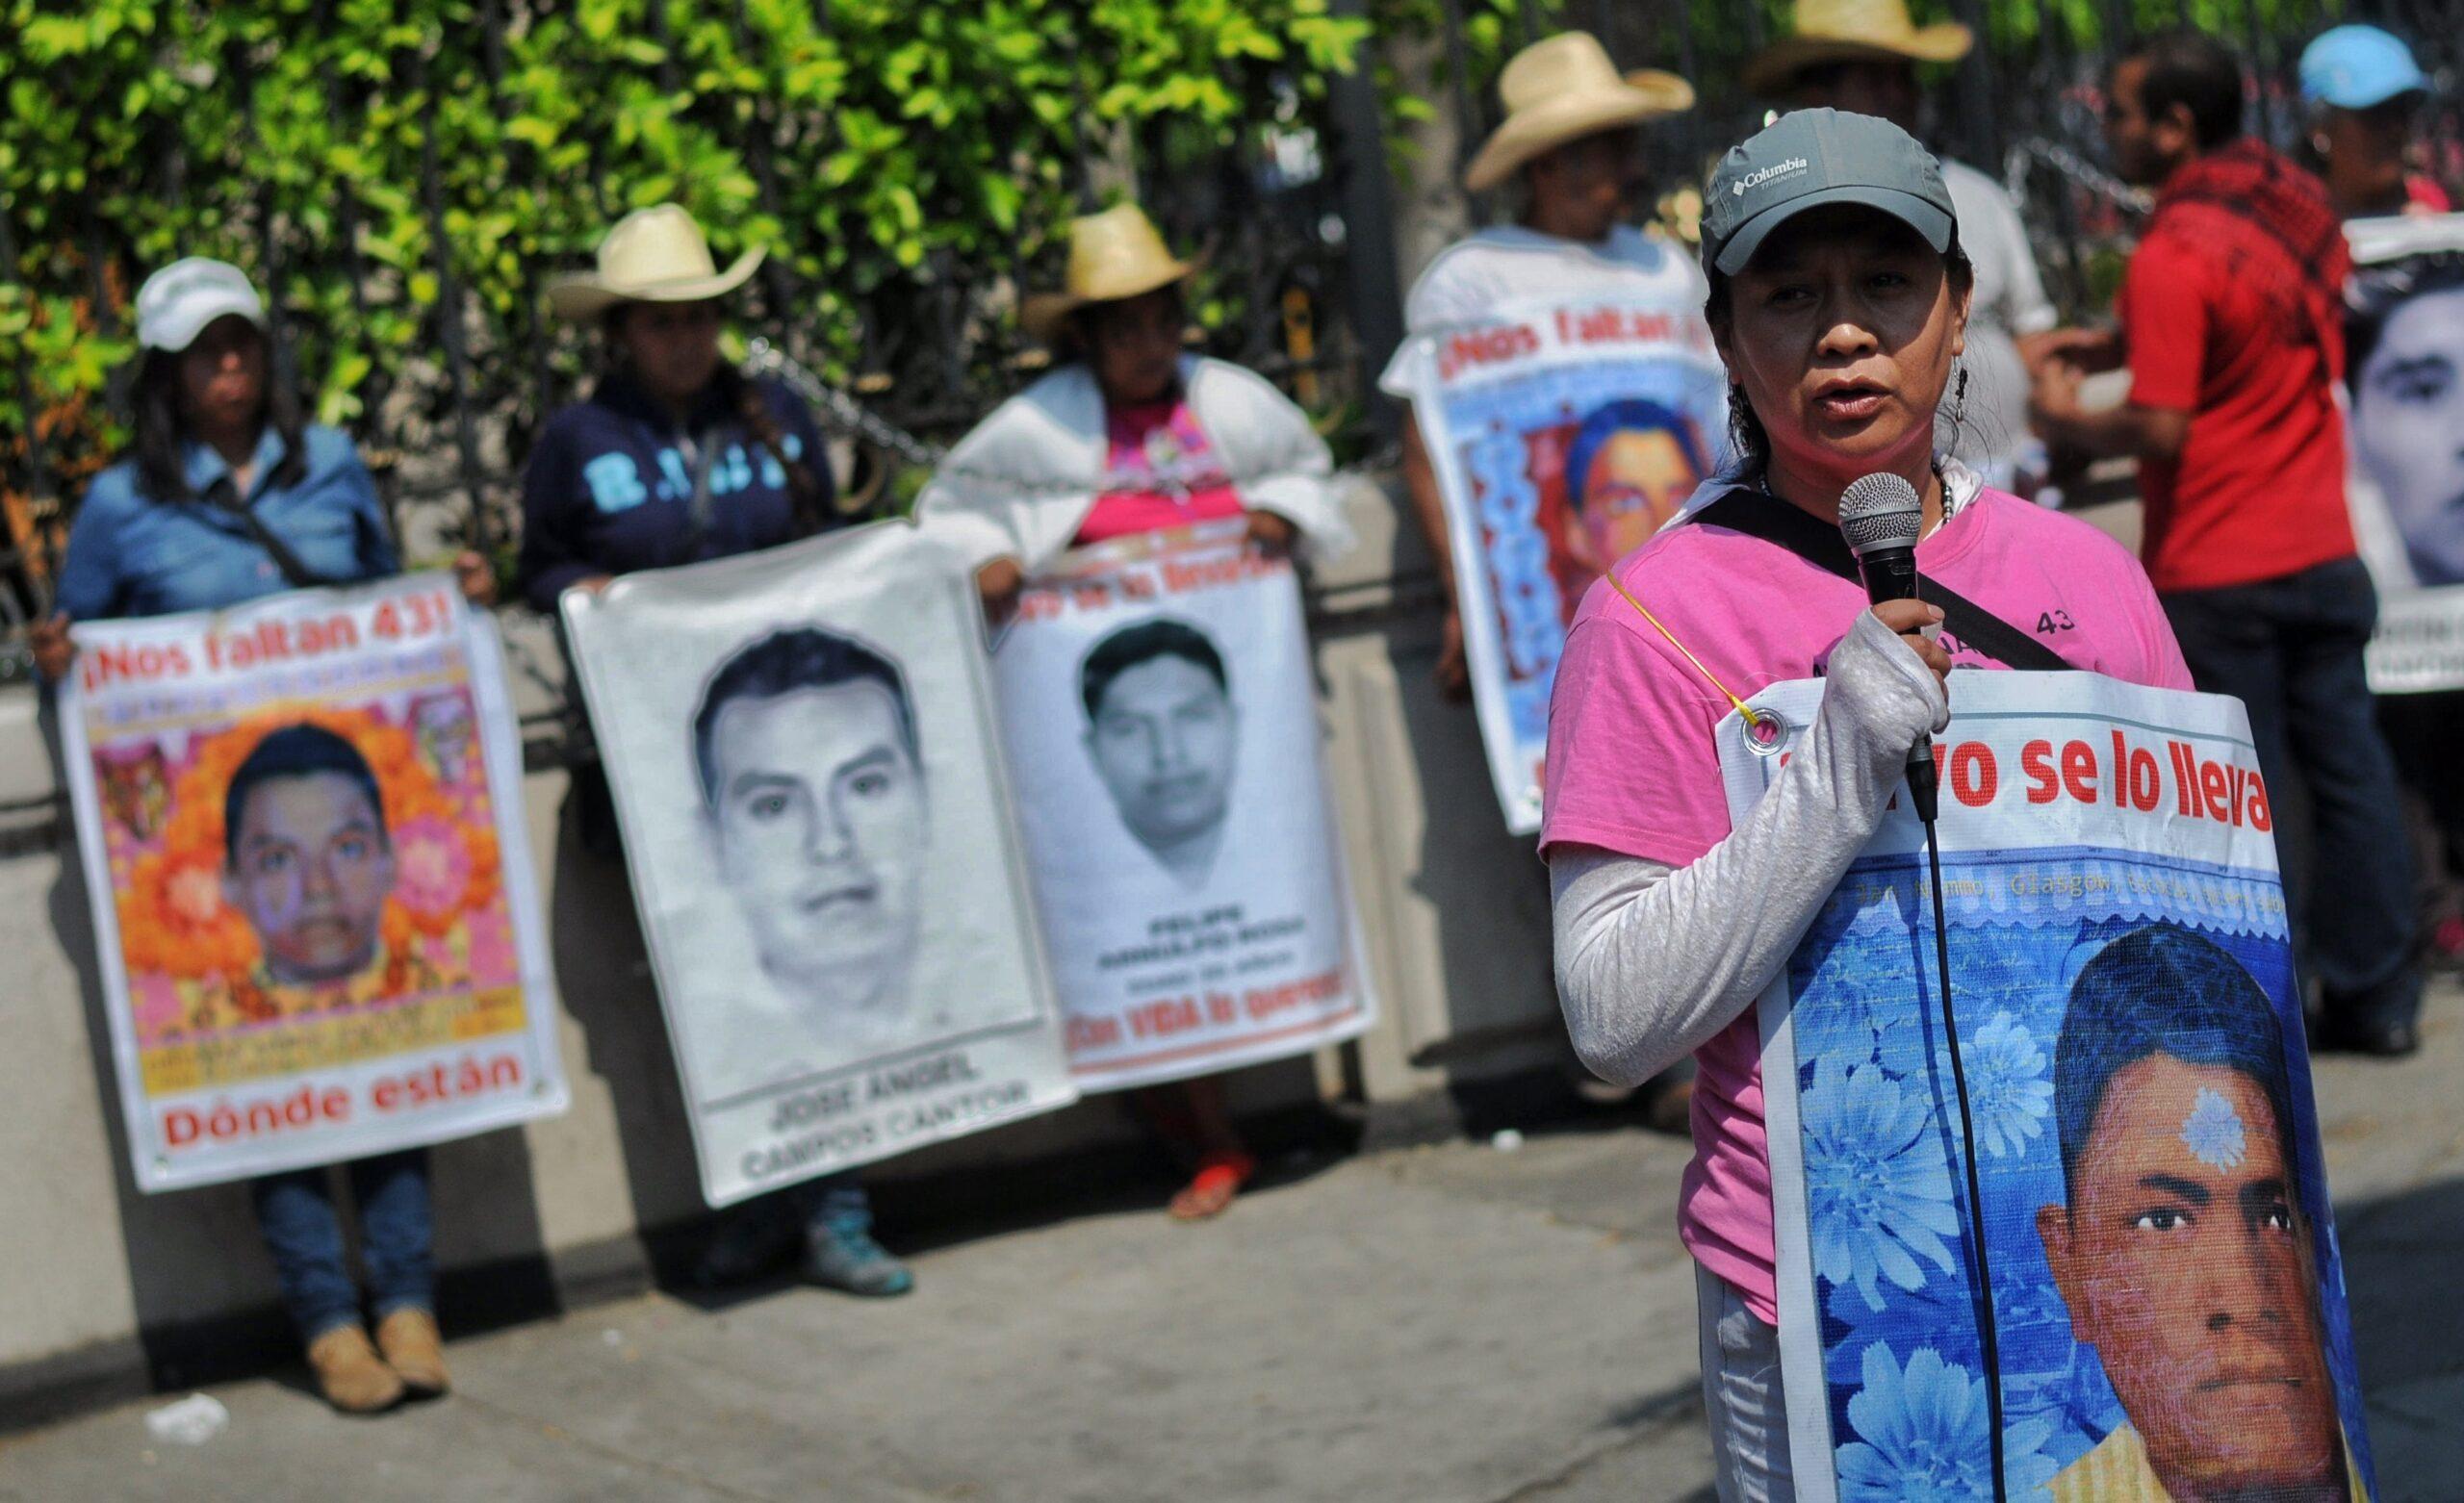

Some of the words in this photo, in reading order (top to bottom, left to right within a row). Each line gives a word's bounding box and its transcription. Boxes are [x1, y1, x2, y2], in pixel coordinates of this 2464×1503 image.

[1744, 157, 1808, 189] Columbia
[1759, 168, 1808, 191] TITANIUM
[2036, 609, 2076, 636] 43
[83, 639, 190, 693] ¡Nos
[203, 613, 359, 671] faltan
[372, 588, 452, 641] 43!
[2020, 738, 2098, 805] se
[2111, 728, 2161, 813] lo
[2167, 739, 2272, 833] lleva
[1914, 879, 1995, 900] Nmmo,
[2010, 873, 2119, 898] Glasgow,
[163, 1083, 351, 1148] Dónde
[371, 1051, 522, 1110] están
